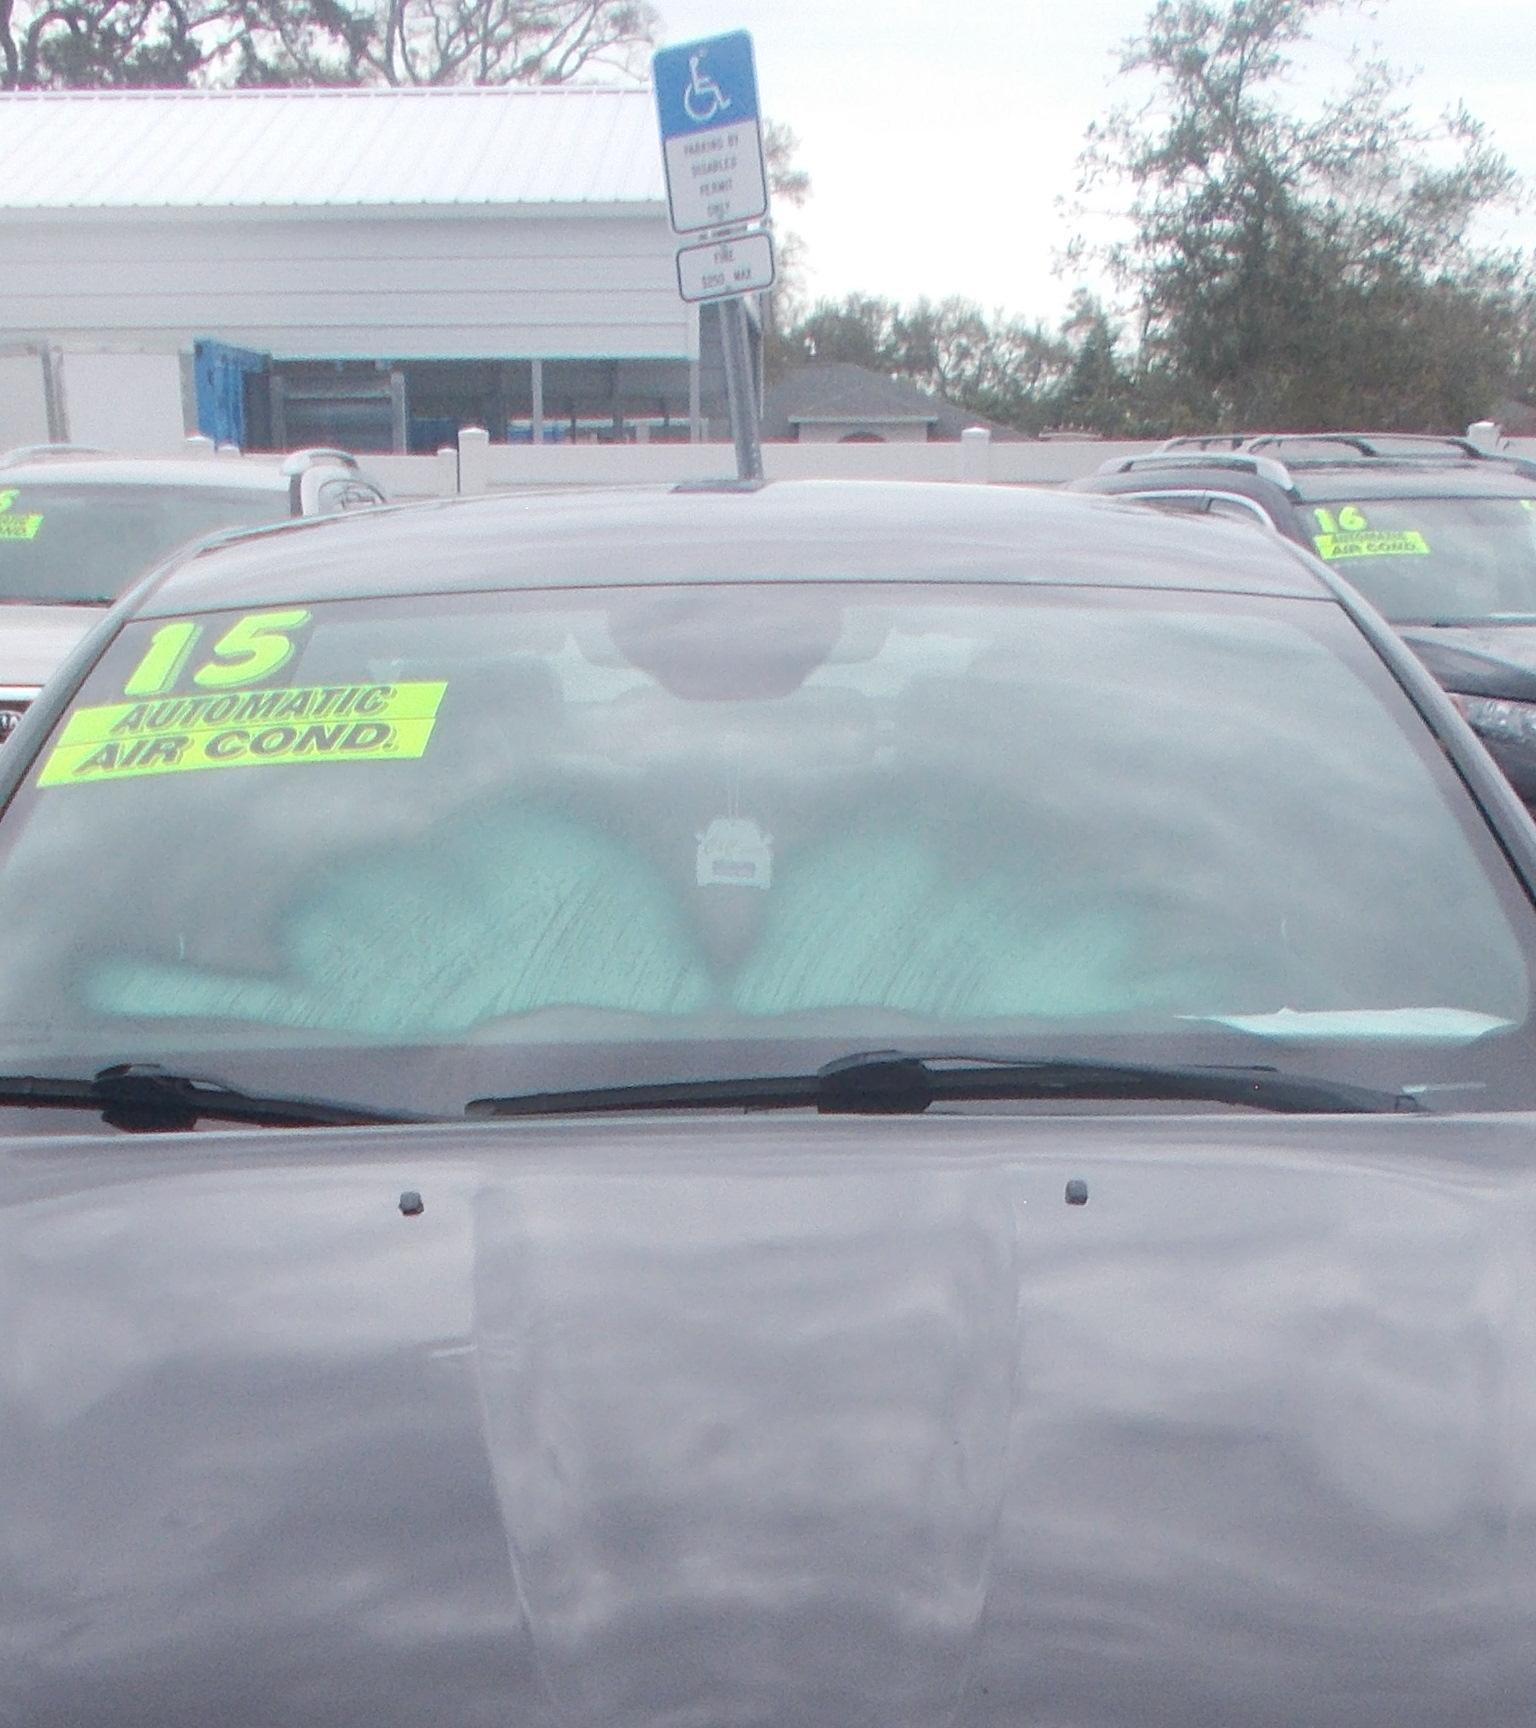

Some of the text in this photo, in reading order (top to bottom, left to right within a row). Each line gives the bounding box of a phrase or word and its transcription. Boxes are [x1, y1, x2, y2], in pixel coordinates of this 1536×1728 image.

[1314, 505, 1368, 533] 16
[1331, 543, 1362, 556] AIR
[124, 610, 313, 695] 15
[110, 686, 397, 735] AUTOMATIC
[75, 722, 399, 775] AIR COND.
